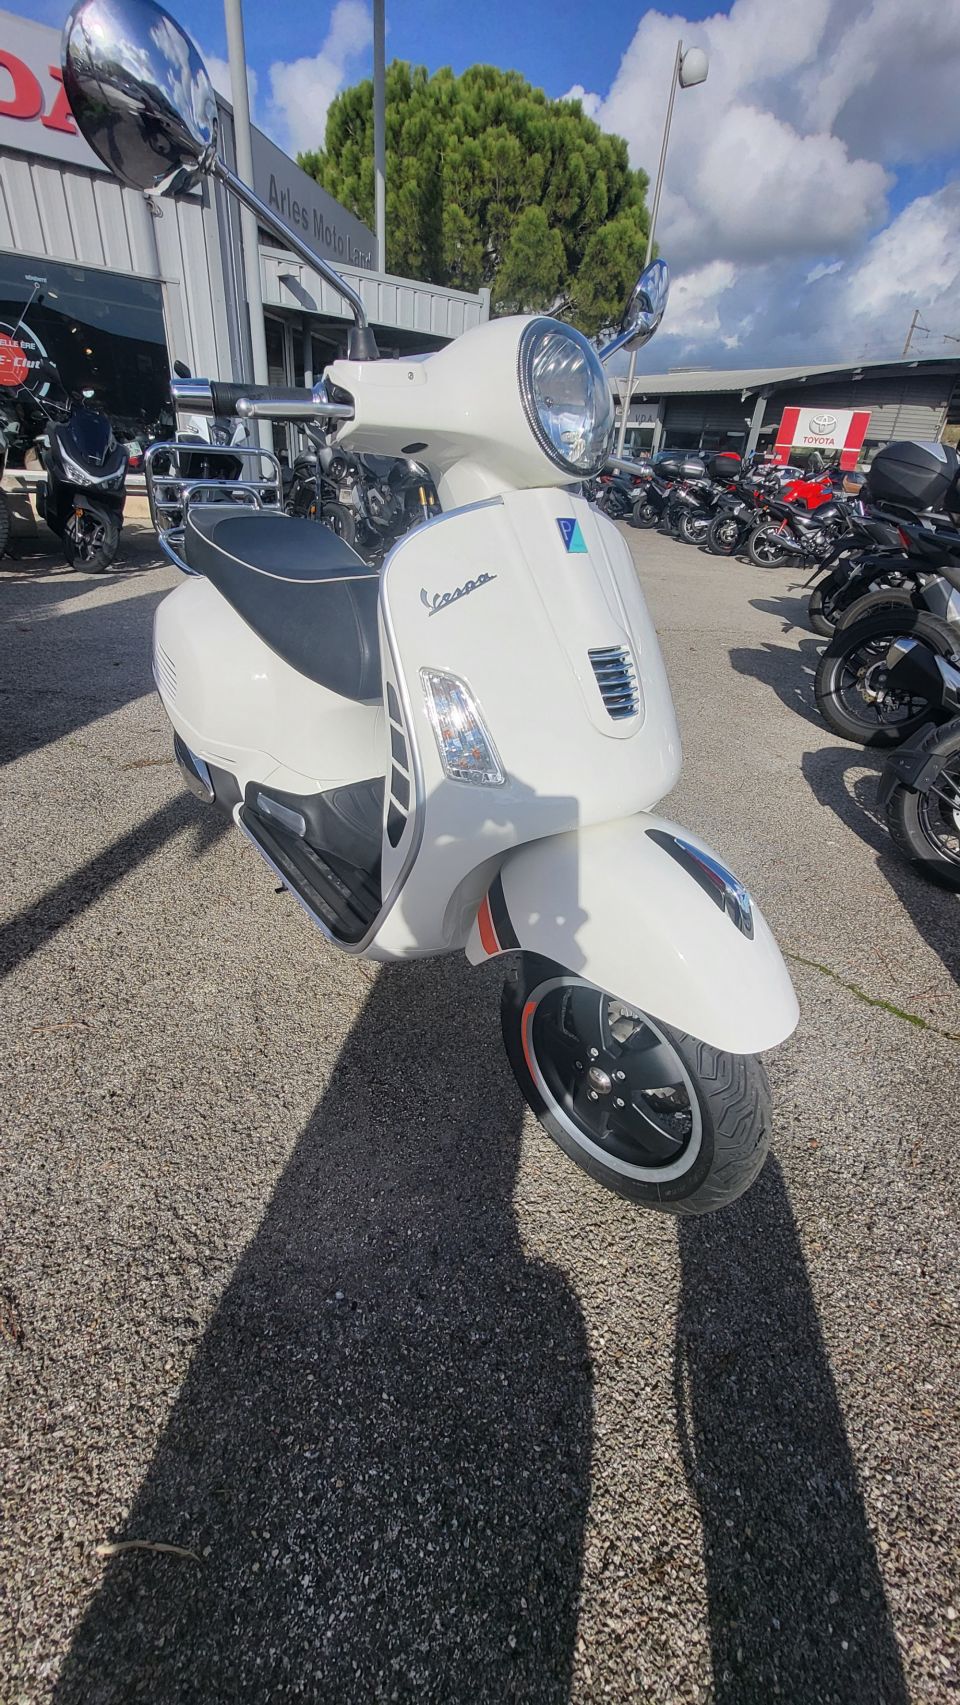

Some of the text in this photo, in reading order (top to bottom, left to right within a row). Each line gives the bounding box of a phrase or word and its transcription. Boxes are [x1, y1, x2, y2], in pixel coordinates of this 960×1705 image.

[268, 173, 309, 231] Arles
[313, 208, 344, 255] Moto
[803, 436, 835, 446] TOYOTA
[420, 572, 498, 617] Vespa
